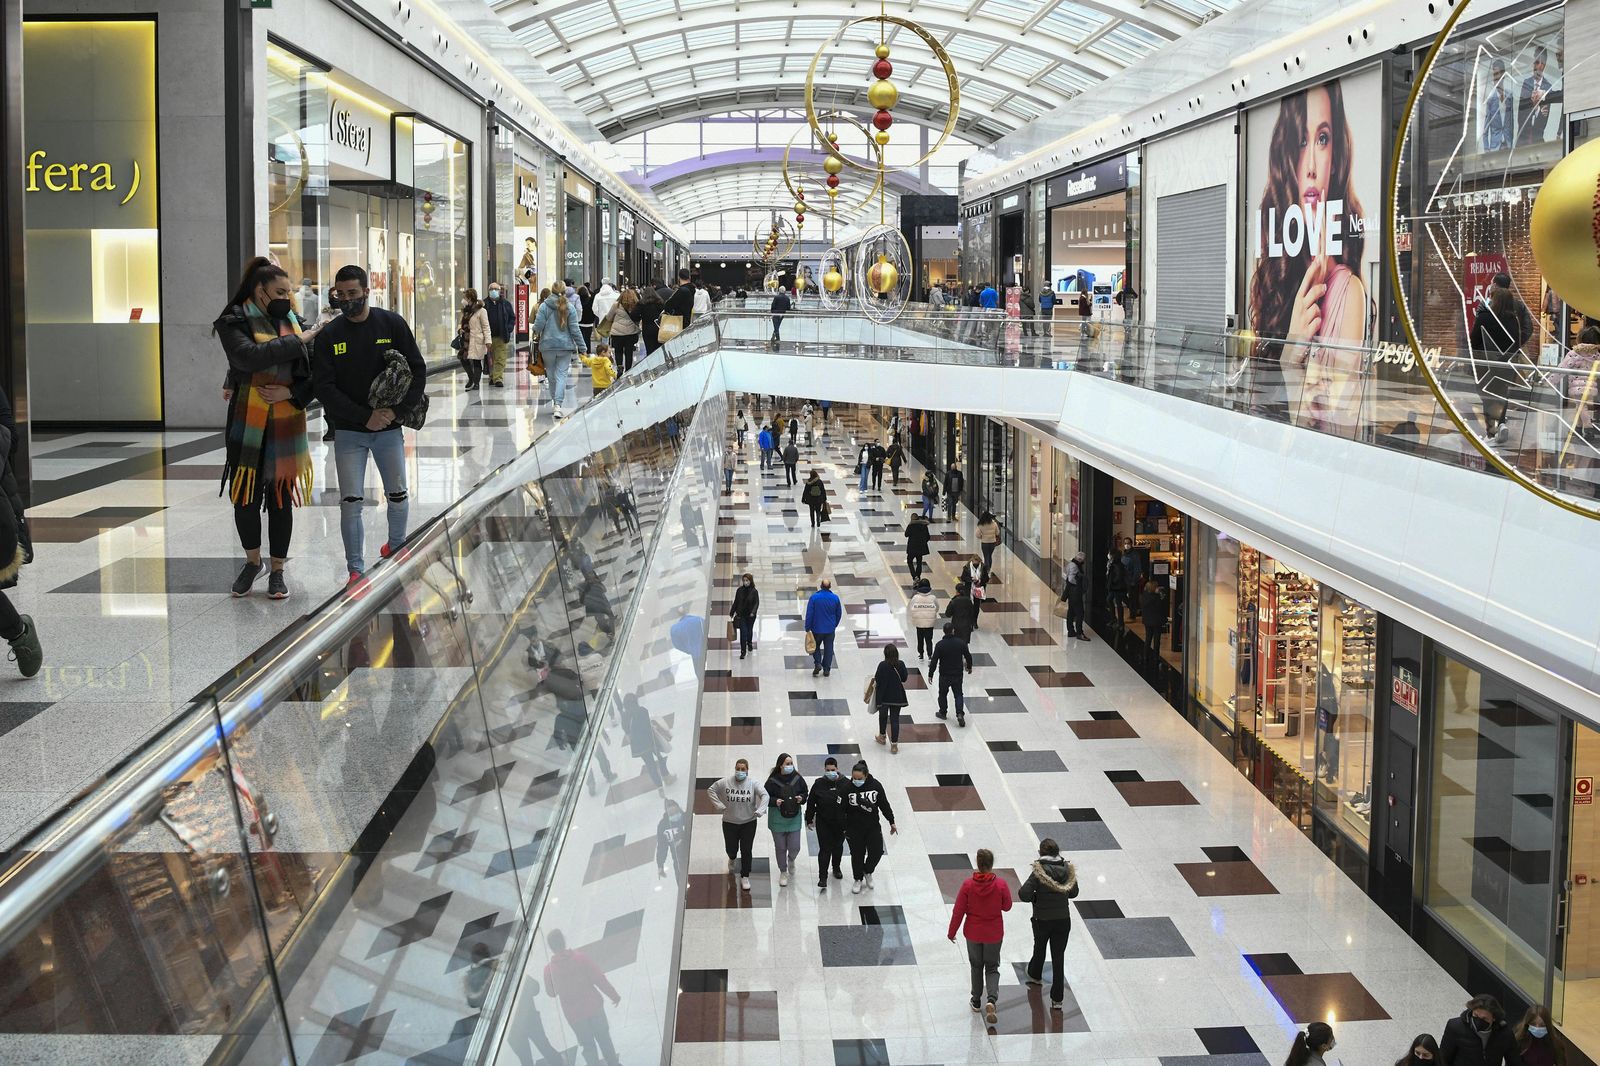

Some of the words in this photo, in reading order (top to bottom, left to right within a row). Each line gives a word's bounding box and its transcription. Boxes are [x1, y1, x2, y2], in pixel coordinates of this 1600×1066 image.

[1254, 209, 1262, 258] I
[1268, 199, 1343, 258] LOVE
[1470, 260, 1501, 274] REBAJAS
[333, 342, 347, 355] 19
[1373, 341, 1442, 373] Desigal
